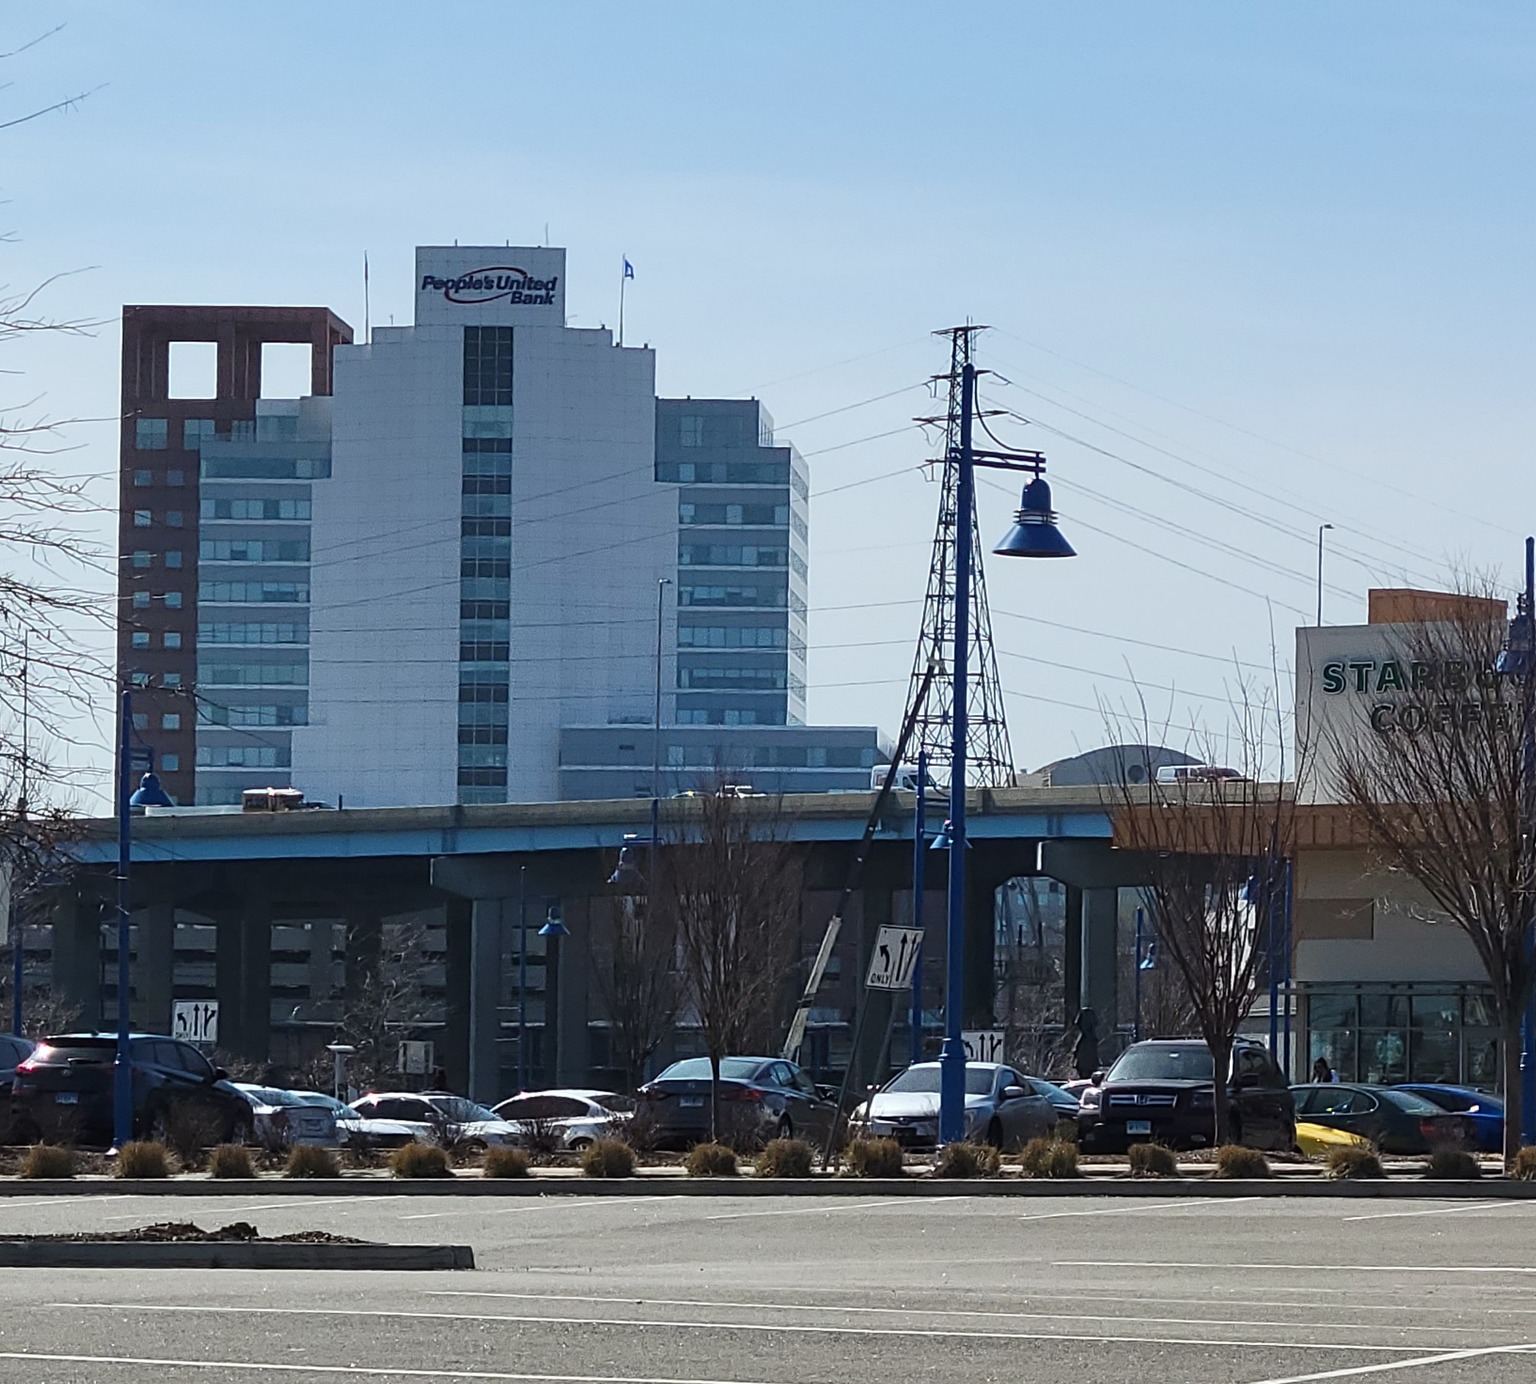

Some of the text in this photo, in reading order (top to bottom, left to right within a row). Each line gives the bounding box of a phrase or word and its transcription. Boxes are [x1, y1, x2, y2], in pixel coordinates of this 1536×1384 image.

[421, 274, 558, 293] People's United
[510, 290, 556, 305] Bank
[1370, 701, 1532, 735] COFFE
[870, 972, 889, 985] ONLY
